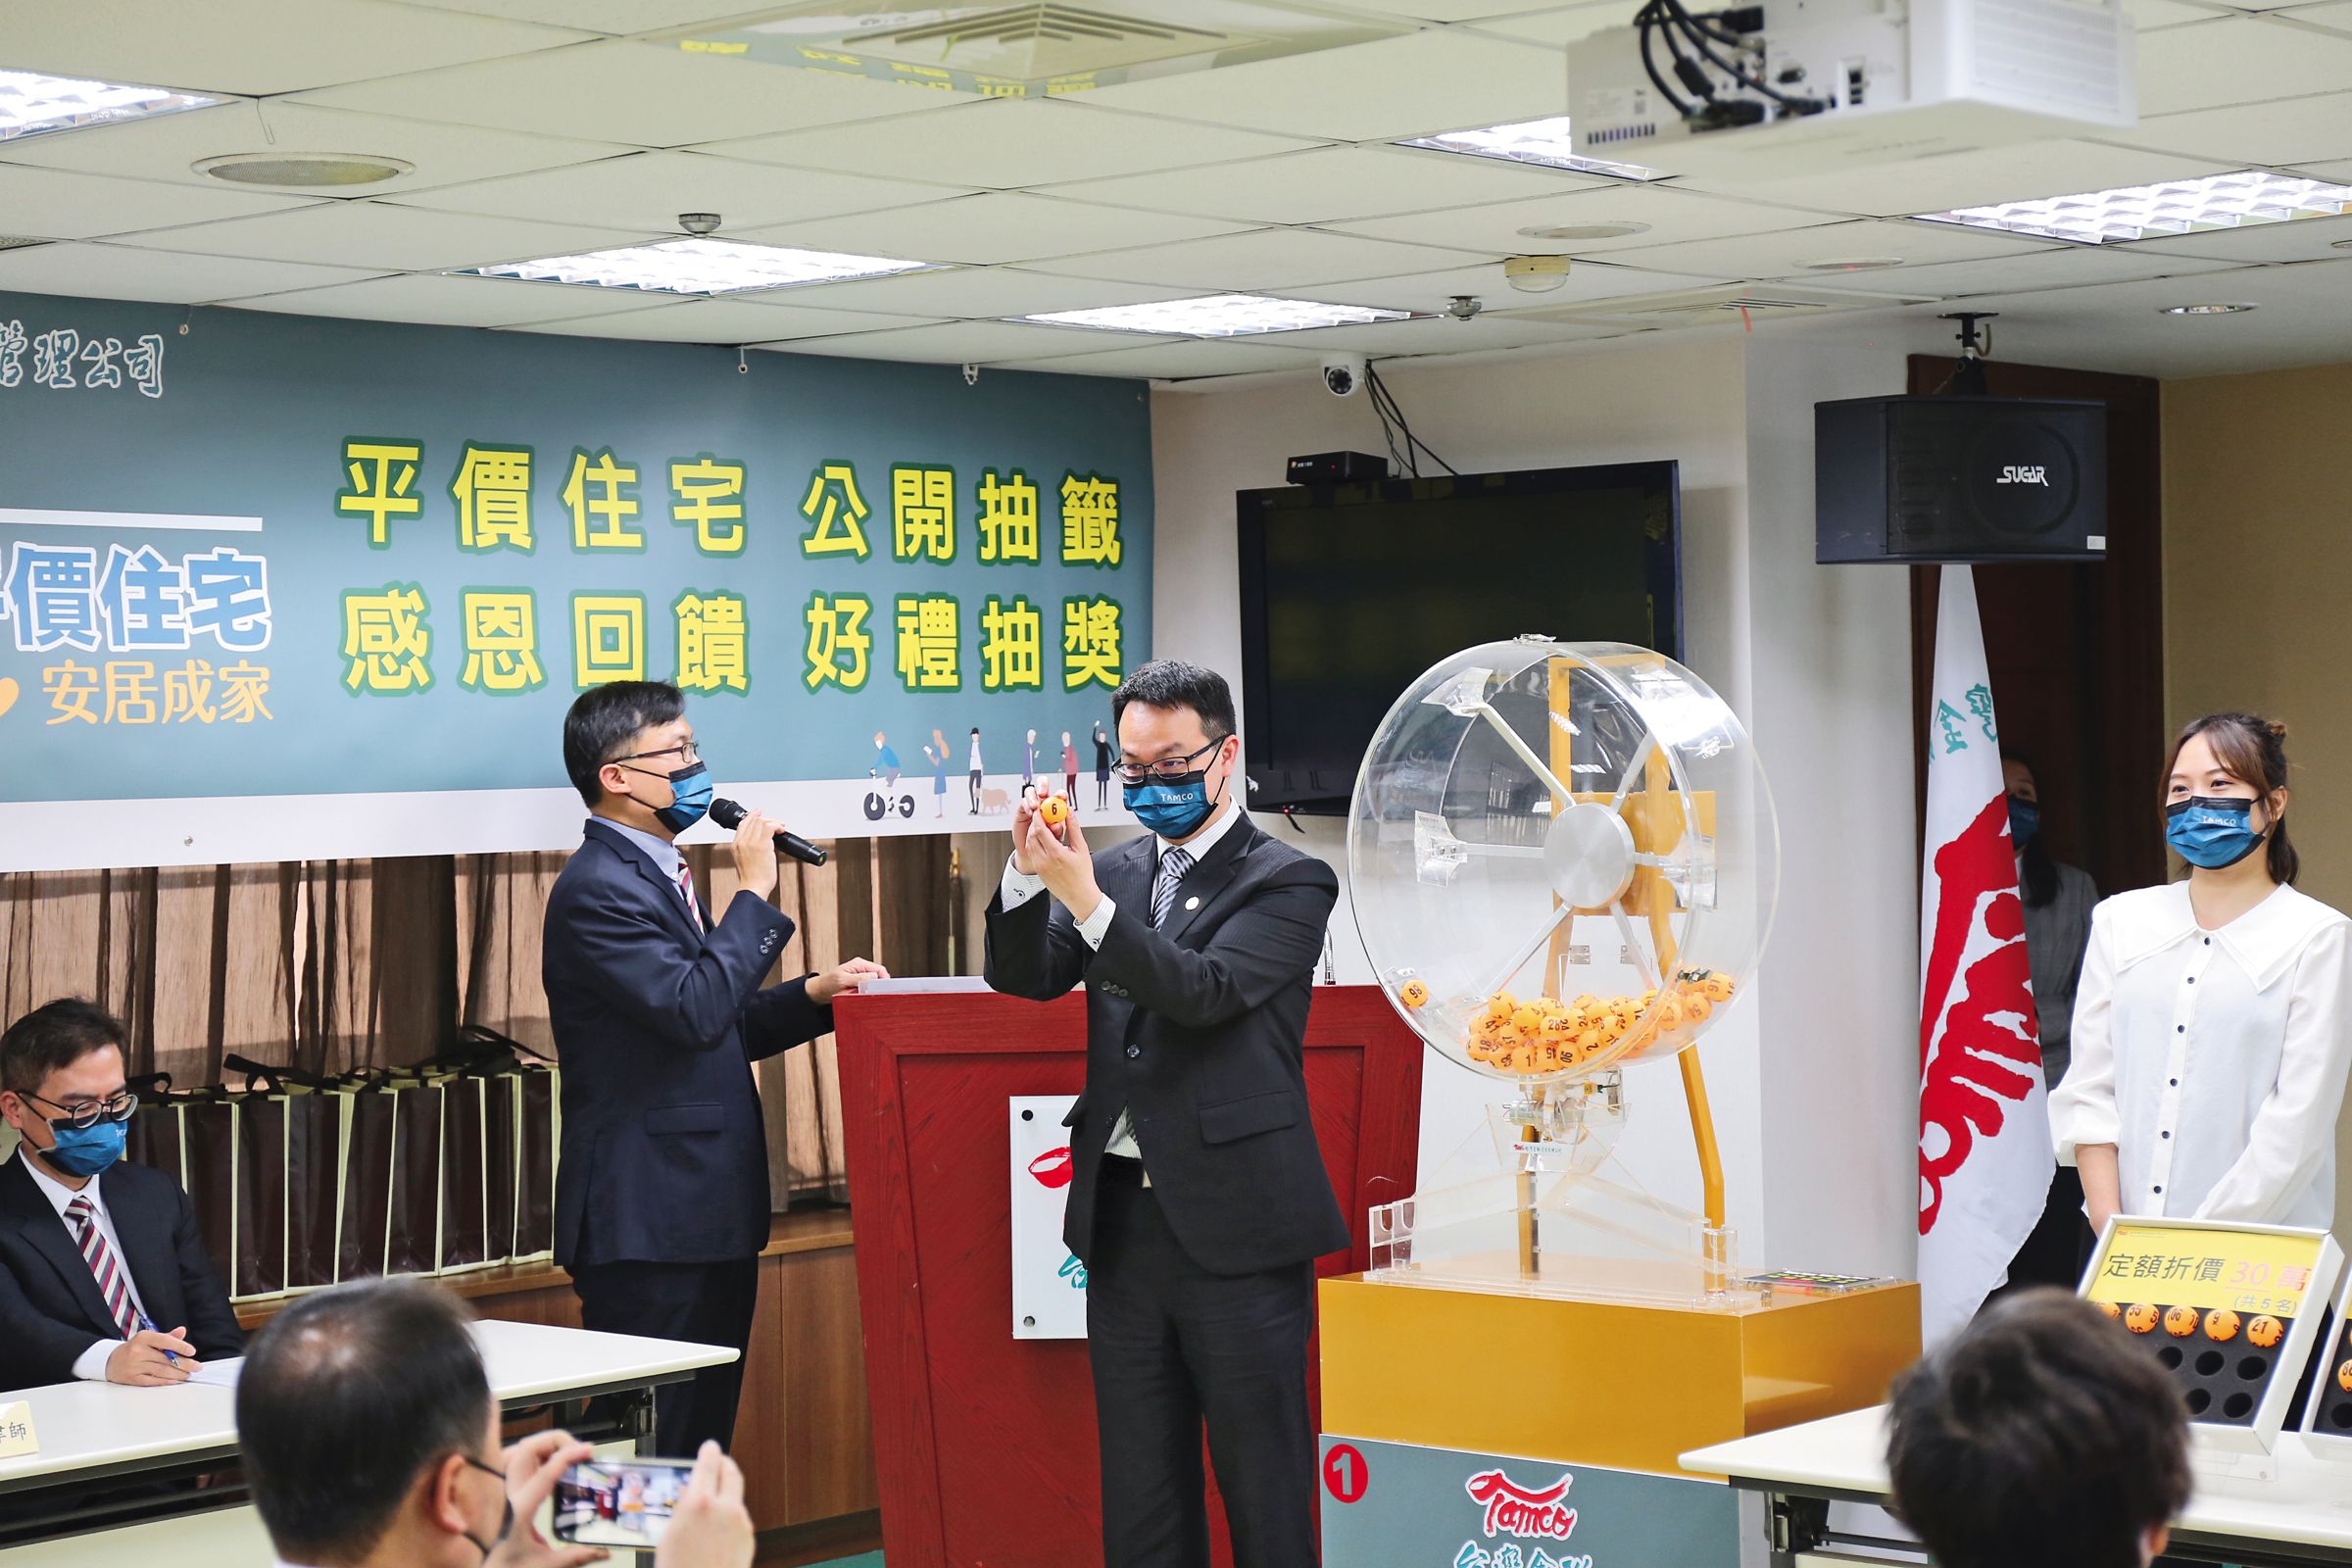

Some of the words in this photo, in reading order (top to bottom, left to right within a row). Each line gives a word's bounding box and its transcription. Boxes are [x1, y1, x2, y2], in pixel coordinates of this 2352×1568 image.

[1996, 466, 2049, 487] SUGAR
[337, 438, 747, 555] 平價住宅
[801, 463, 1125, 565] 公開抽籤
[0, 541, 271, 653] 價住宅
[340, 585, 749, 694] 感恩回饋
[804, 592, 1124, 691] 好禮抽獎
[42, 659, 273, 725] 安居成家
[1052, 803, 1057, 815] 6
[1160, 792, 1194, 802] TAMCO
[2103, 1253, 2226, 1283] 定額折價
[2230, 1261, 2271, 1287] 30
[2277, 1263, 2312, 1292] 萬
[2260, 1298, 2271, 1310] 5
[2251, 1318, 2269, 1335] 21
[1332, 1451, 1353, 1496] 1
